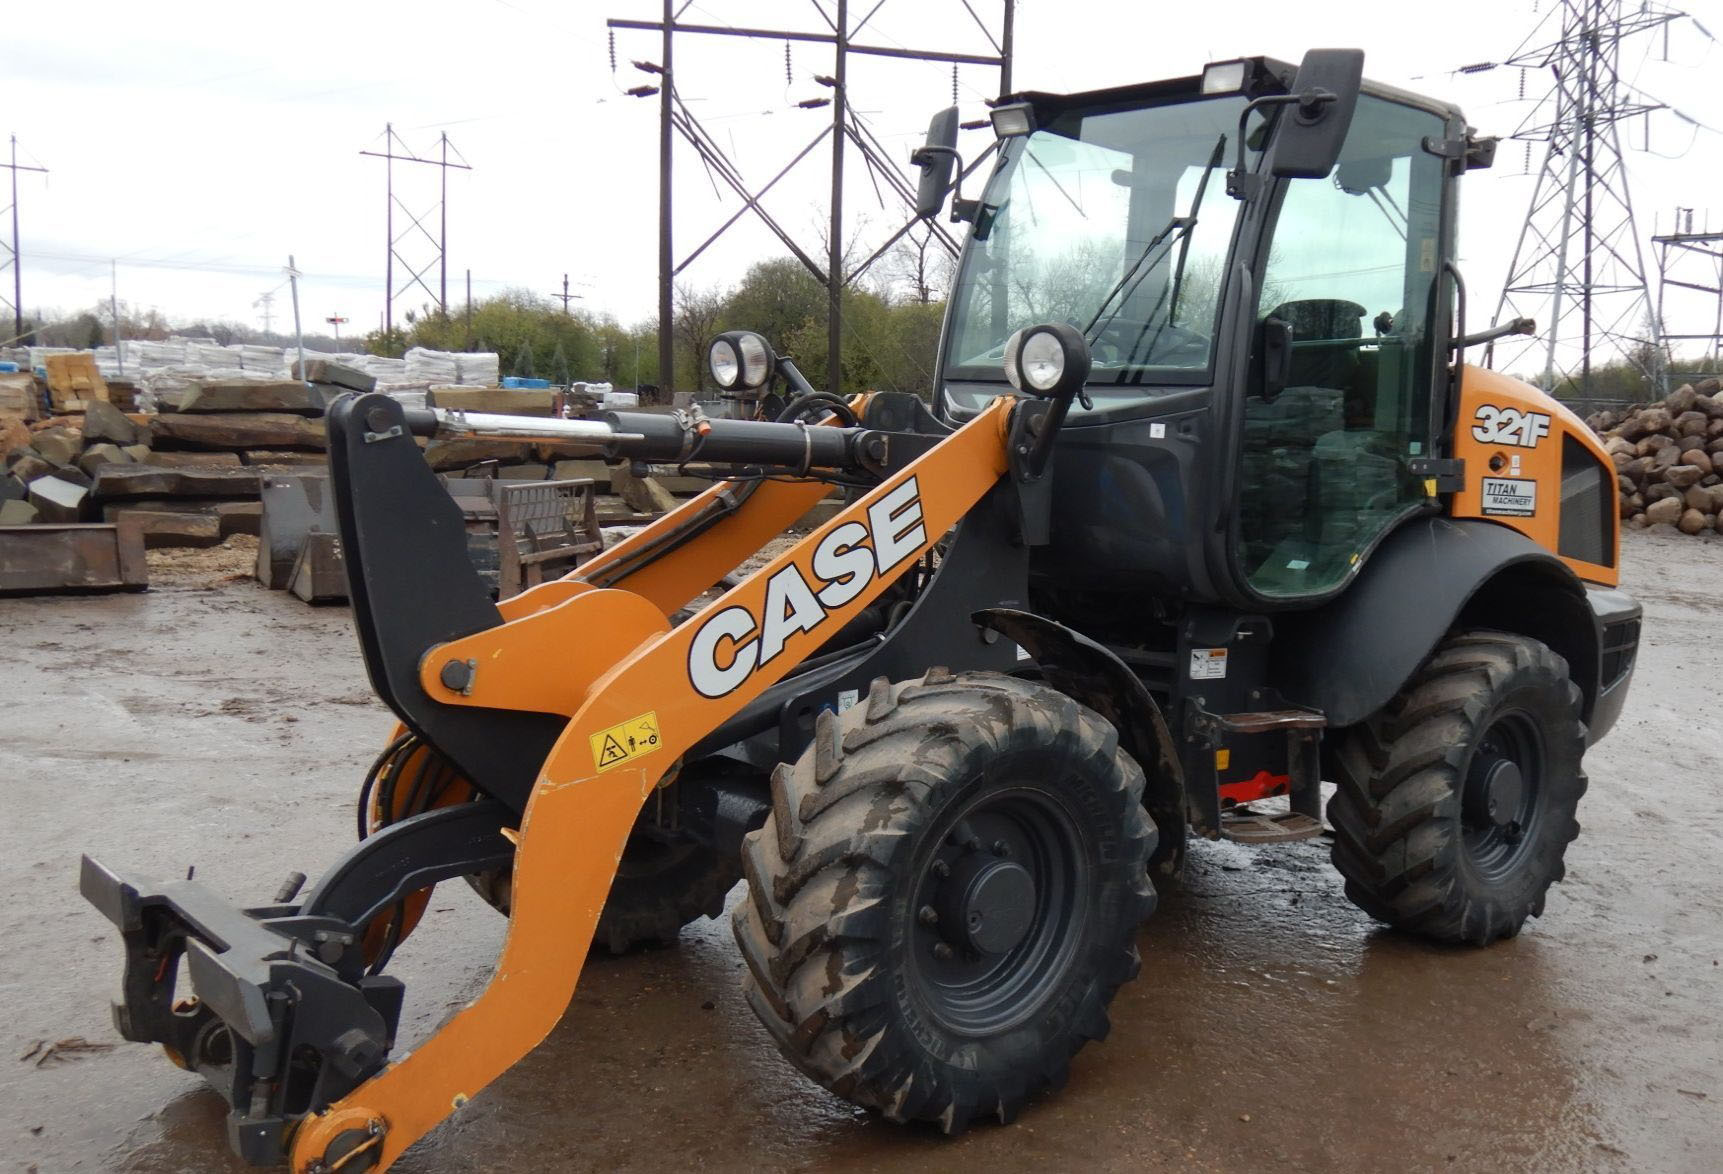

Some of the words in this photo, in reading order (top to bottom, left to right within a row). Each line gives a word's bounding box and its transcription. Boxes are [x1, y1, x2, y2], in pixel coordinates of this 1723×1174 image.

[1472, 404, 1551, 448] 321F
[1487, 482, 1518, 495] TITAN
[1492, 497, 1532, 506] MACHINERY
[688, 473, 927, 699] CASE
